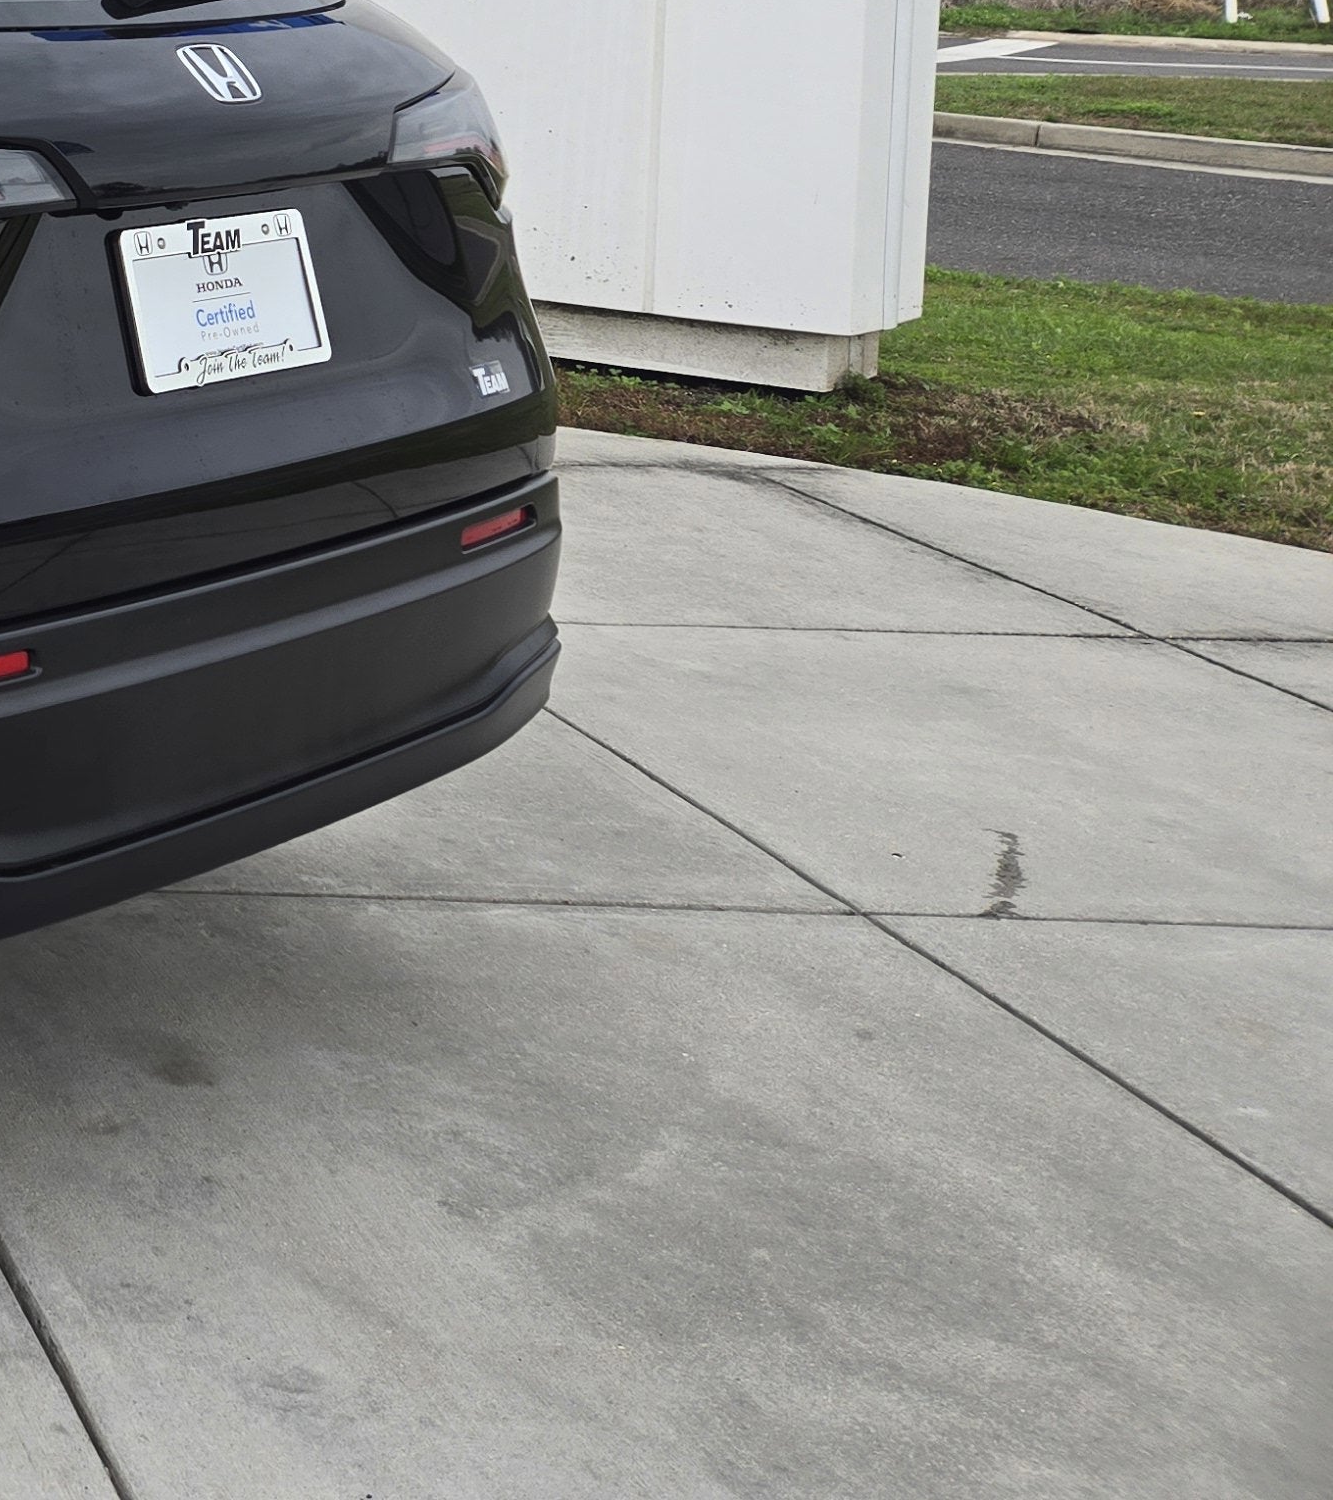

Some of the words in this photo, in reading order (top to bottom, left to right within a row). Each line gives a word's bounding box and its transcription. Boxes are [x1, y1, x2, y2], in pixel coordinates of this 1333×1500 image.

[186, 221, 242, 256] TEAM
[196, 277, 243, 294] HONDA
[195, 299, 256, 327] Certified
[200, 321, 260, 341] Pre-Owned
[196, 356, 224, 384] Join
[224, 350, 247, 373] The
[248, 346, 286, 368] Team!
[472, 367, 510, 396] TEAM
